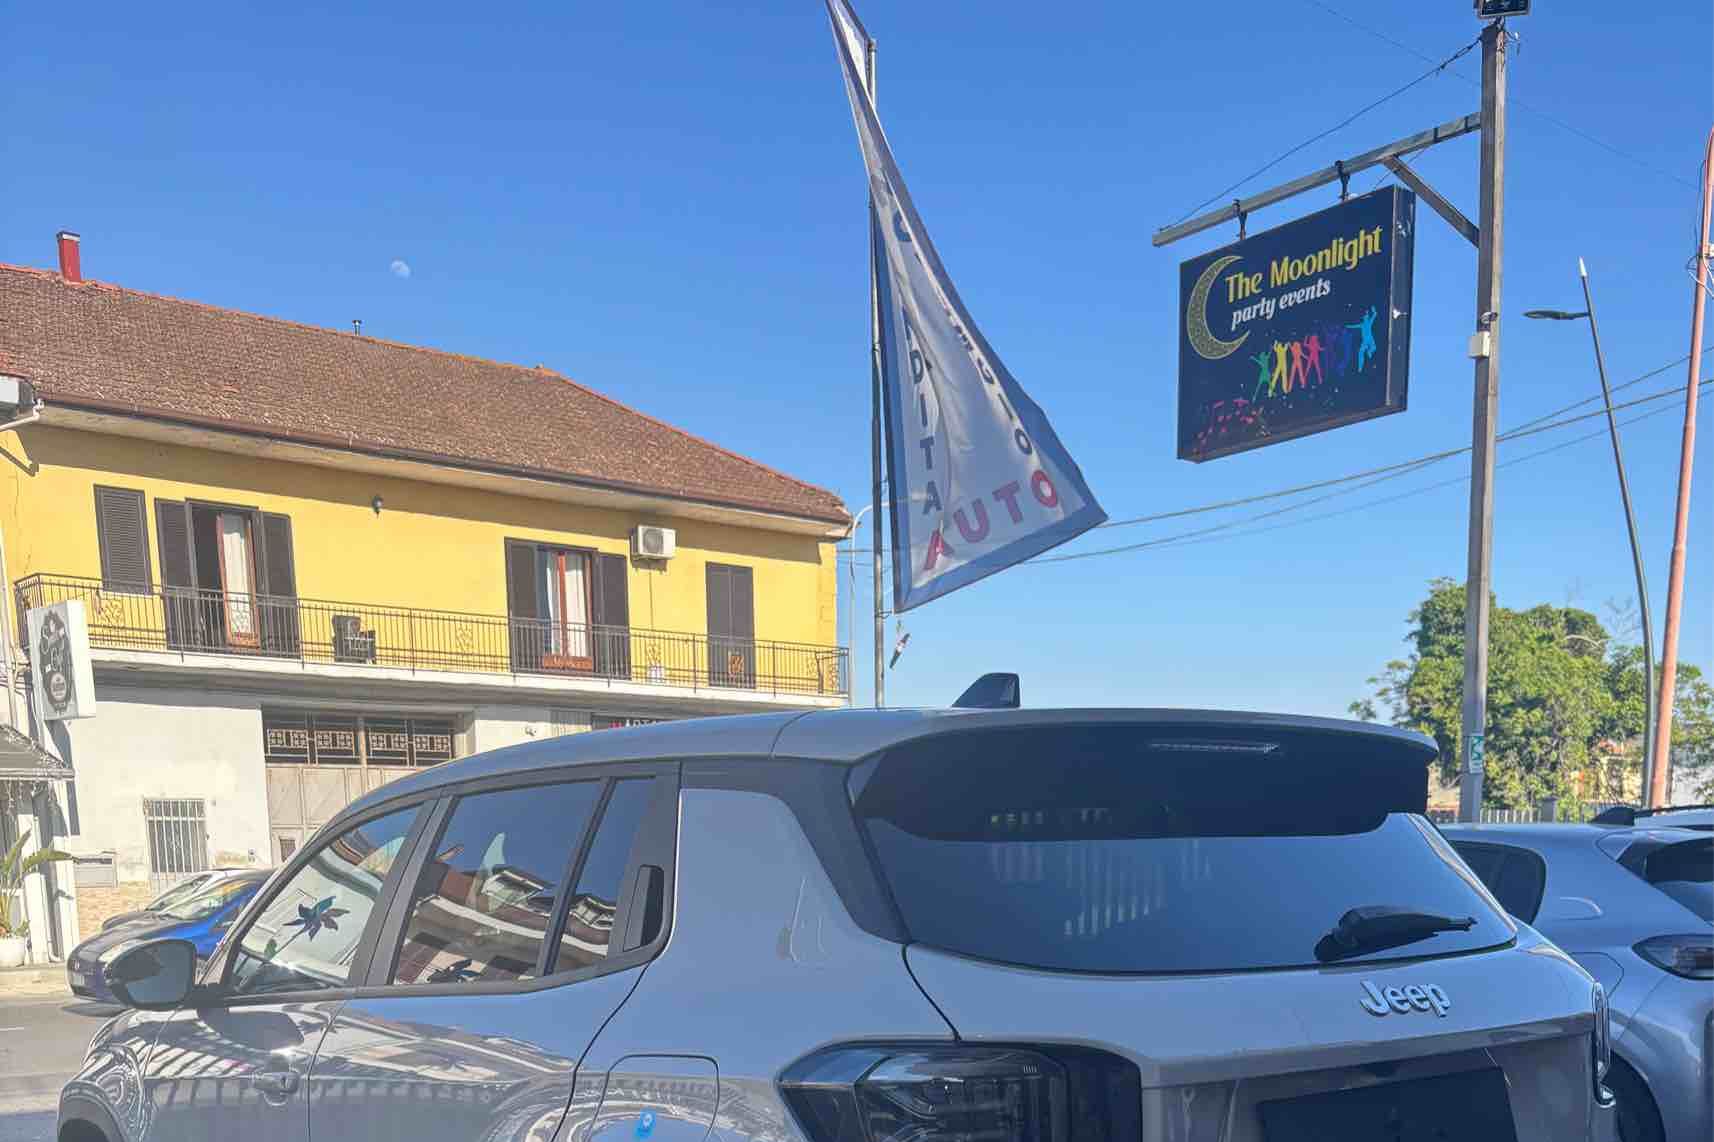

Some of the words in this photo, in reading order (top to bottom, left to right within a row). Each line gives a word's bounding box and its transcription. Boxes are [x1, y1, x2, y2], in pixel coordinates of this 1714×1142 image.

[1225, 271, 1263, 303] The
[1270, 224, 1383, 288] Moonlight
[1231, 297, 1276, 331] party
[1279, 277, 1331, 310] events
[922, 469, 1058, 571] AUTO
[1359, 979, 1452, 1018] Jeep
